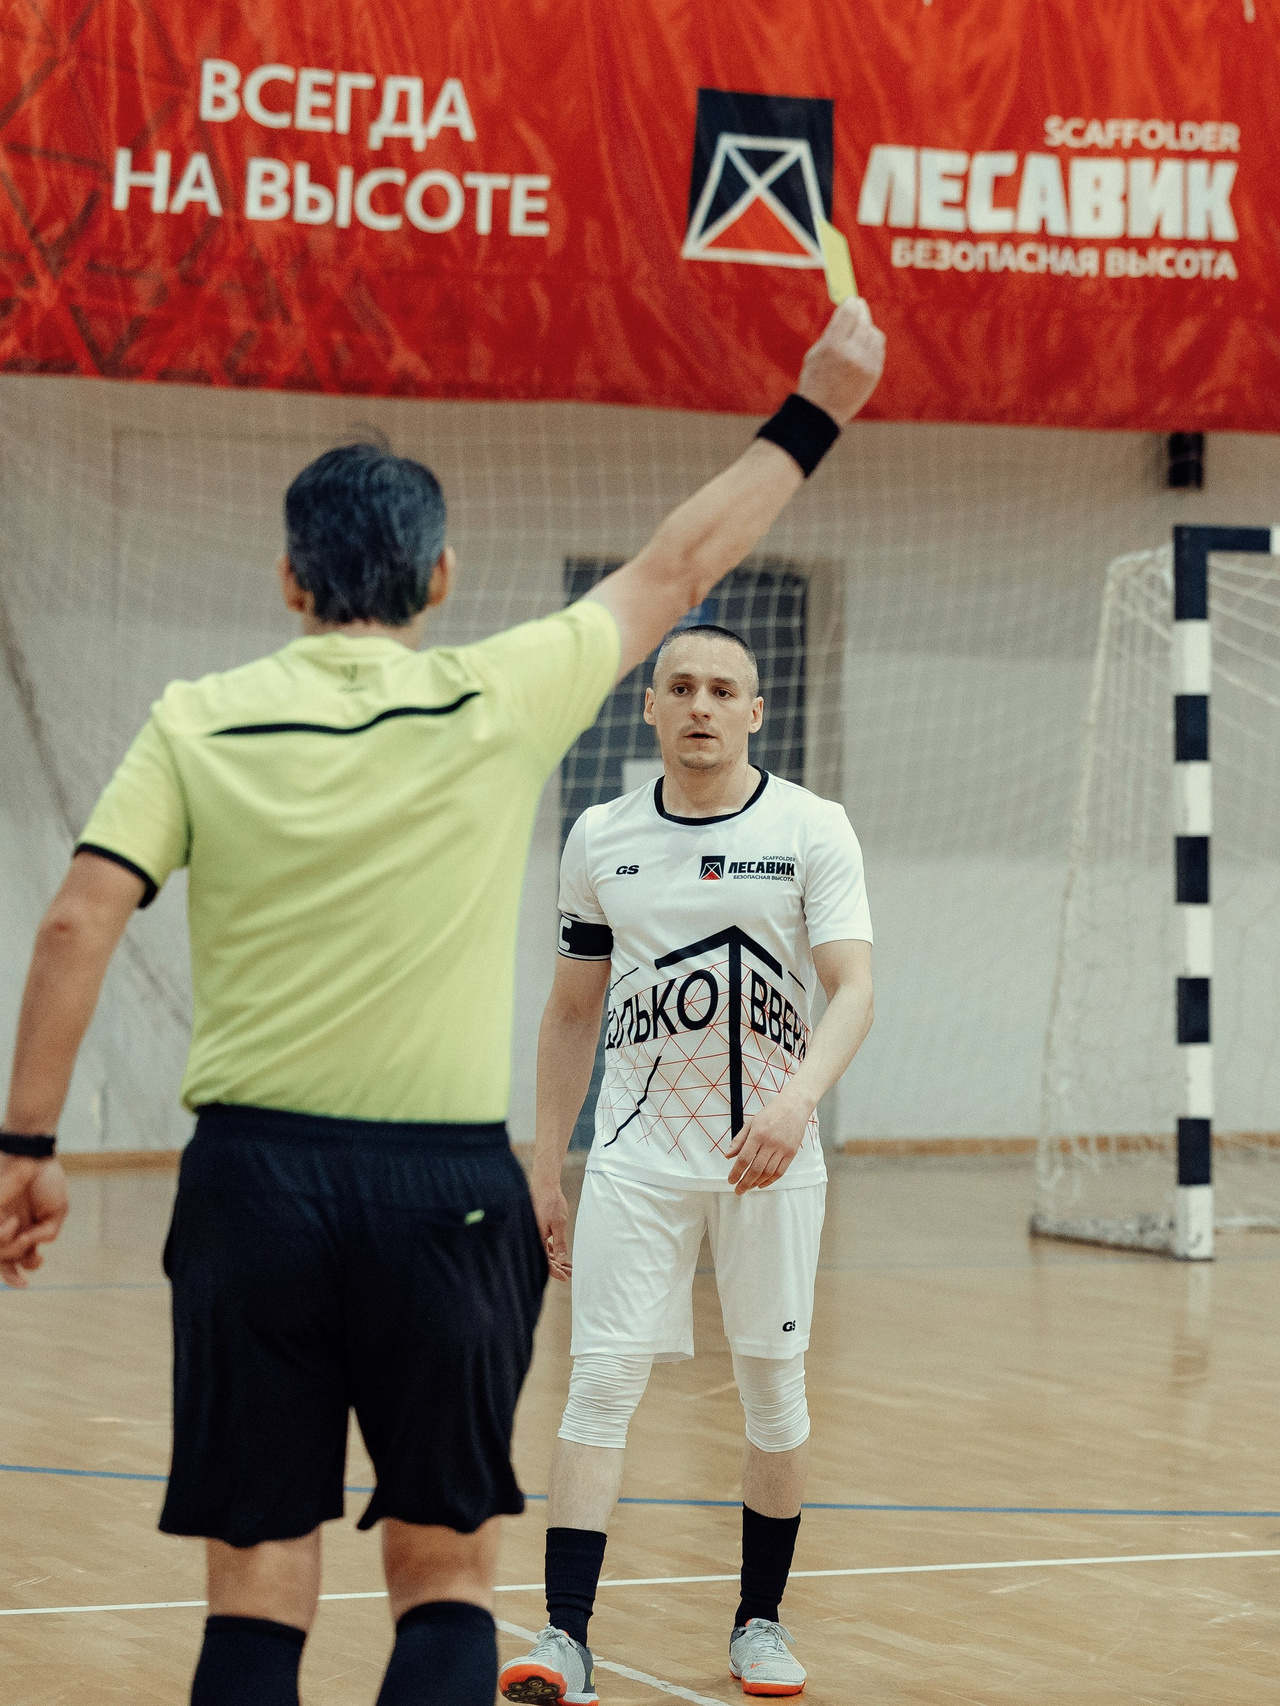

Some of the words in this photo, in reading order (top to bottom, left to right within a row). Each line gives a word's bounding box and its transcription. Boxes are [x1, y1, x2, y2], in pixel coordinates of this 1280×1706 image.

[196, 58, 477, 152] ВСЕГДА
[1044, 115, 1240, 153] SCAFFOLDER
[113, 148, 223, 217] НА
[244, 157, 551, 237] ВЫСОТЕ
[856, 144, 1239, 242] ЛЕСАВИК
[890, 237, 1099, 278] БЕЗОПАСНАЯ
[1103, 246, 1239, 281] ВЫСОТА
[615, 864, 640, 875] GS
[728, 861, 796, 877] ЛЕСАВИК
